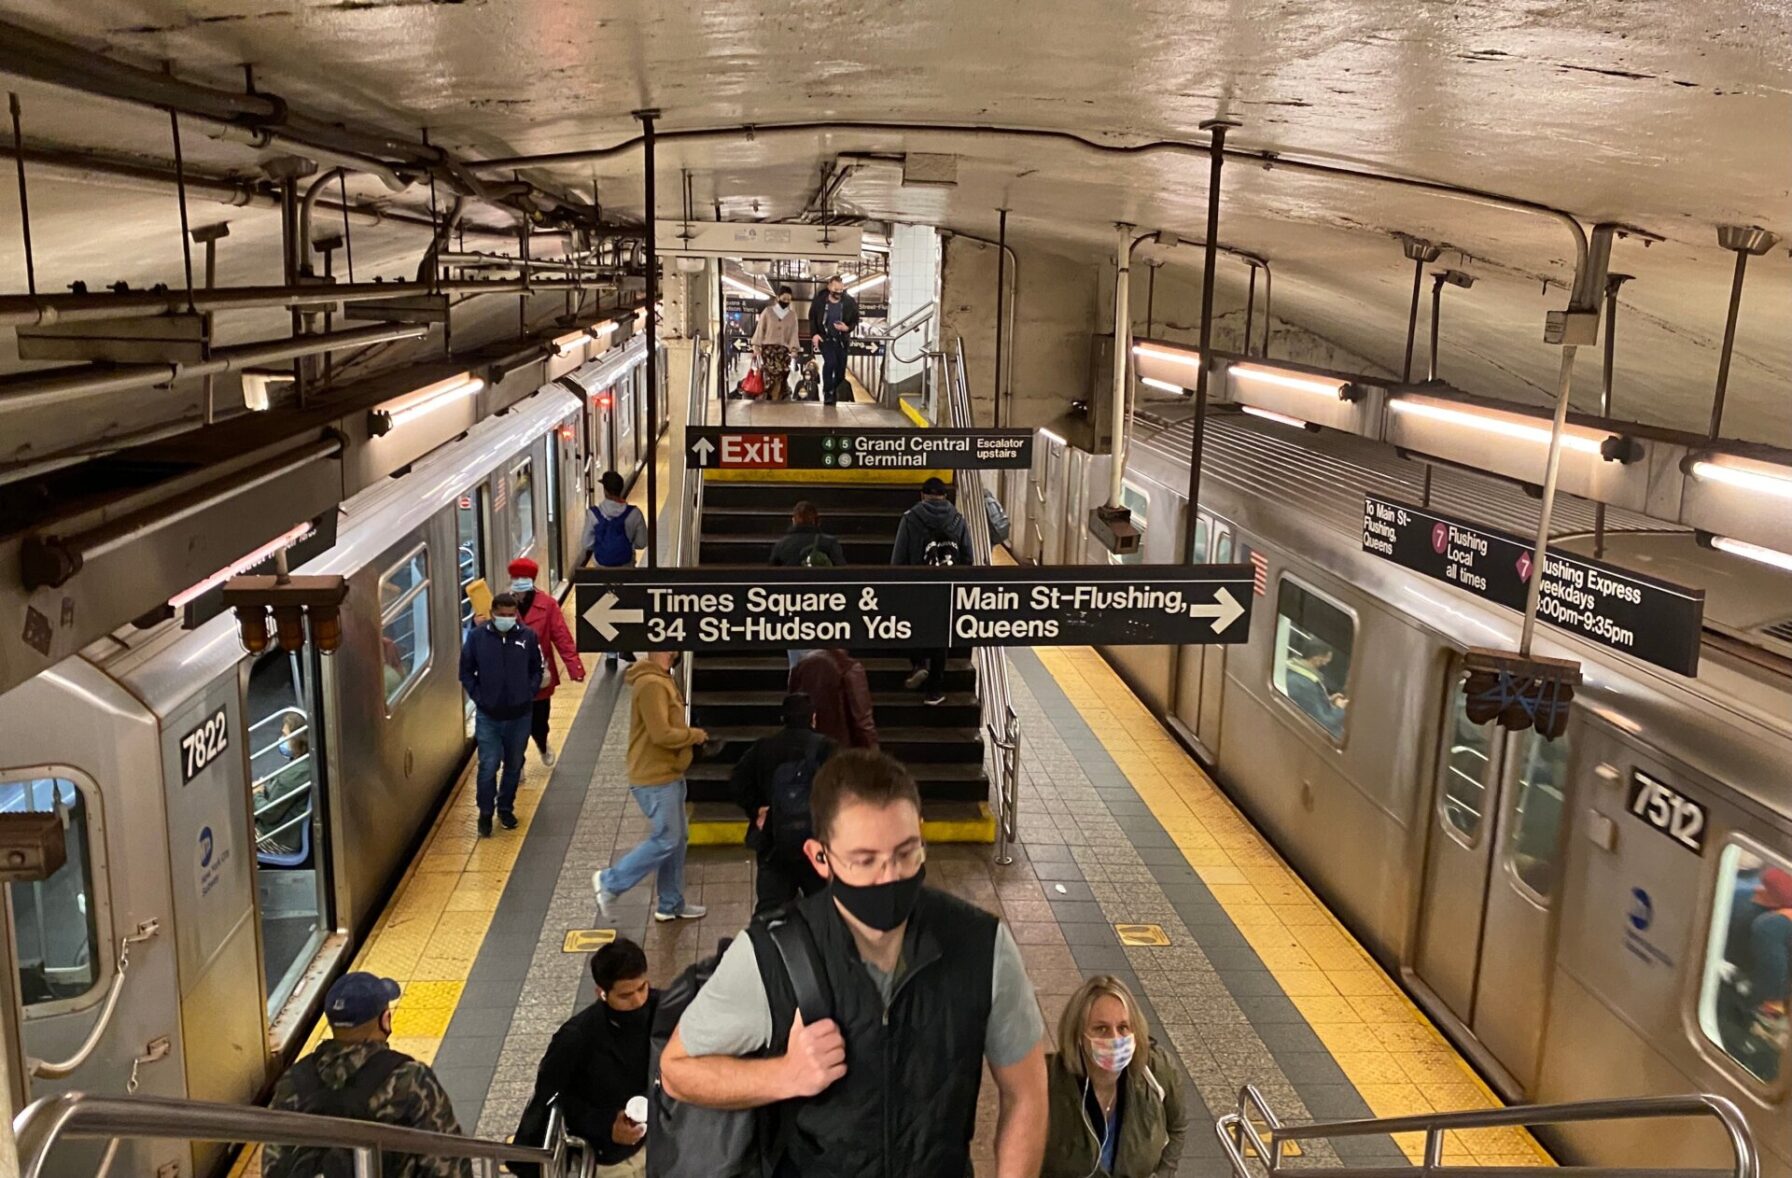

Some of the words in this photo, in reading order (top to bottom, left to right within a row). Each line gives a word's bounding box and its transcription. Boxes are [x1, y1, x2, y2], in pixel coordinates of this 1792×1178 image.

[720, 436, 784, 463] Exit
[825, 439, 832, 448] 4
[842, 439, 849, 449] 5
[855, 437, 906, 451] Grand
[910, 437, 970, 451] Central
[976, 438, 1024, 448] Escalator
[976, 449, 1017, 459] upstairs
[825, 455, 832, 465] 6
[841, 455, 849, 465] S
[855, 452, 927, 466] Terminal
[1365, 499, 1375, 515] To
[1376, 503, 1395, 523] Main
[1396, 509, 1412, 527] St-
[1363, 516, 1397, 543] Flushing,
[1436, 530, 1444, 547] 7
[1448, 526, 1488, 556] Flushing
[1363, 532, 1393, 555] Queens
[1447, 544, 1474, 567] Local
[1446, 564, 1457, 579] all
[1459, 567, 1487, 590] times
[1521, 559, 1530, 577] 7
[1542, 555, 1584, 588] lushing
[1587, 569, 1642, 605] Express
[647, 588, 735, 613] Times
[746, 587, 847, 616] Square
[858, 586, 879, 611] &
[956, 586, 1019, 610] Main
[1029, 585, 1187, 615] St-Flushing,
[647, 617, 687, 642] 34
[698, 613, 851, 642] St-Hudson
[862, 615, 912, 639] Yds
[955, 614, 1059, 639] Queens
[182, 711, 227, 778] 7822
[1633, 772, 1704, 849] 7512
